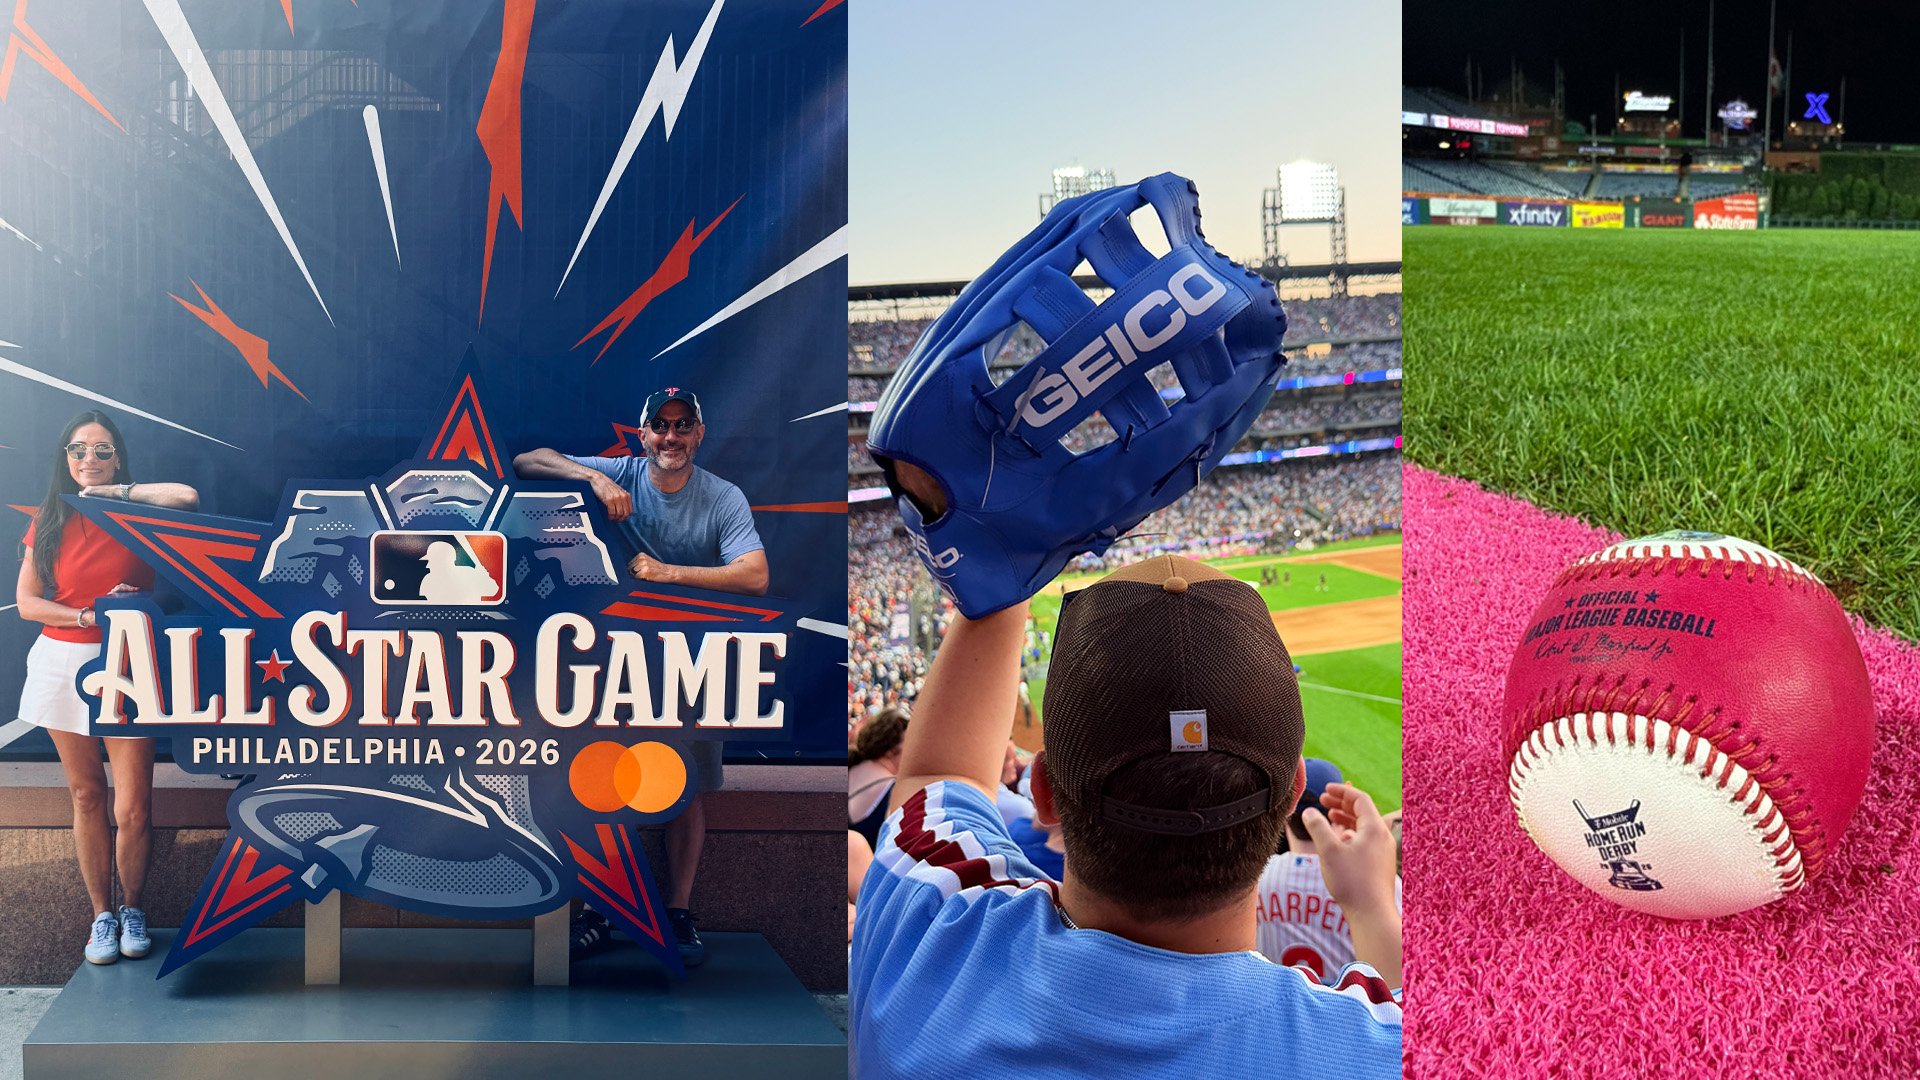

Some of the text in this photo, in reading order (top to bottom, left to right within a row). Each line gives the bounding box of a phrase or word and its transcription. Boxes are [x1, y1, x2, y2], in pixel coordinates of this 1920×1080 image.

[1509, 204, 1562, 226] xfinity
[1643, 215, 1684, 226] GIANT
[1015, 263, 1227, 428] GEICO
[1577, 591, 1638, 607] OFFICIAL
[1565, 608, 1620, 630] LEAGUE
[1623, 608, 1716, 639] BASEBALL
[288, 610, 522, 728] STAR
[535, 612, 787, 728] GAME
[193, 738, 560, 765] PHILADELPHIA 2026
[1584, 821, 1646, 848] HOME RUN
[1598, 840, 1637, 861] DERBY
